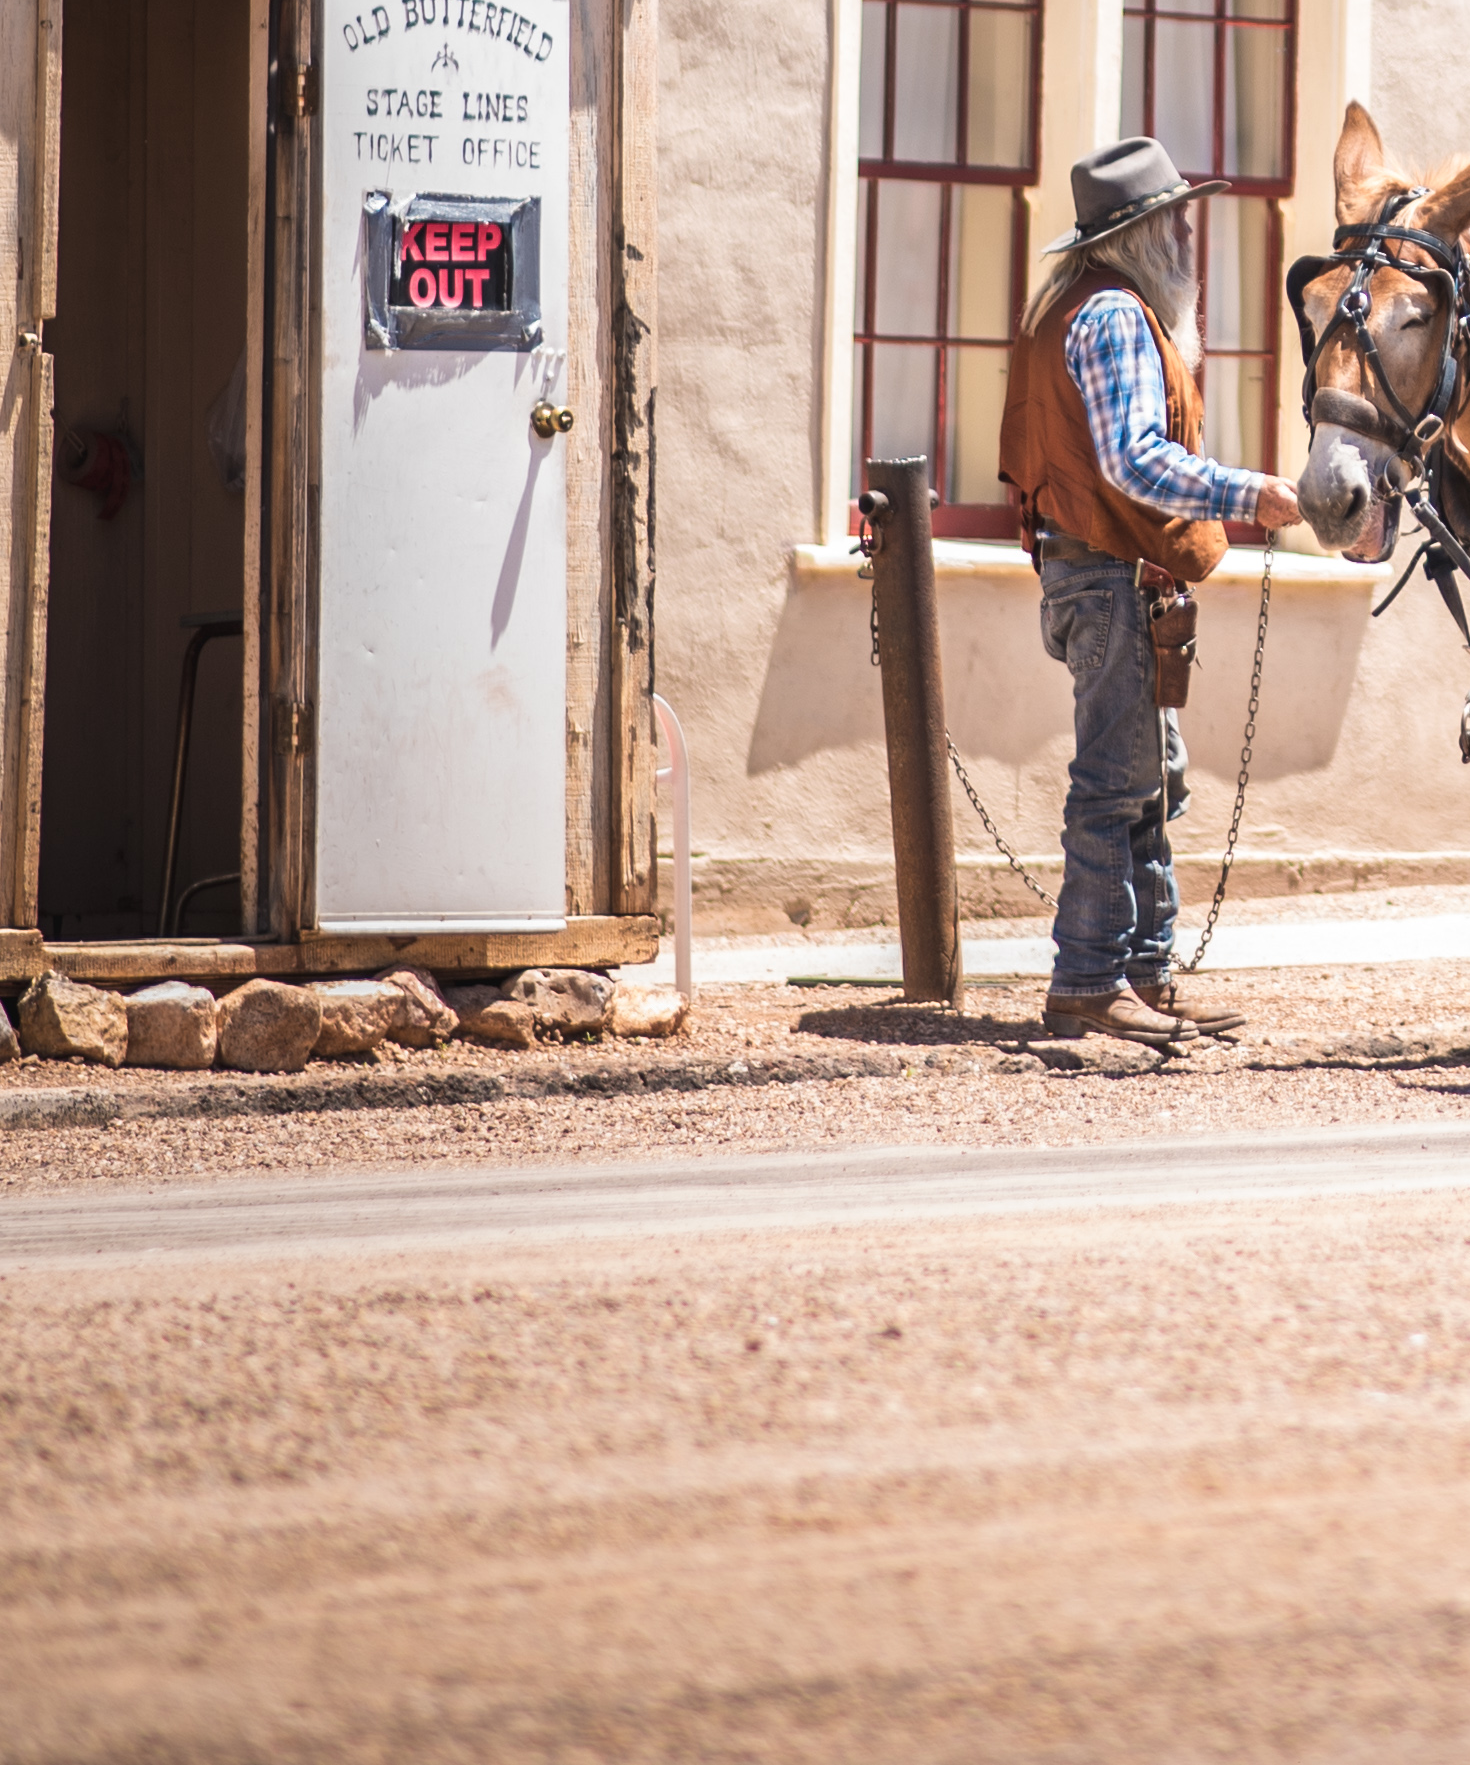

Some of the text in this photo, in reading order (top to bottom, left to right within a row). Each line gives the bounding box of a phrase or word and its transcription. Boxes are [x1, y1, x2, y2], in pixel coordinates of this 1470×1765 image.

[343, 5, 391, 52] OLD
[366, 88, 529, 123] STAGE LINES
[353, 131, 541, 170] TICKET OFFICE
[401, 222, 503, 262] KEEP
[409, 268, 491, 309] OUT
